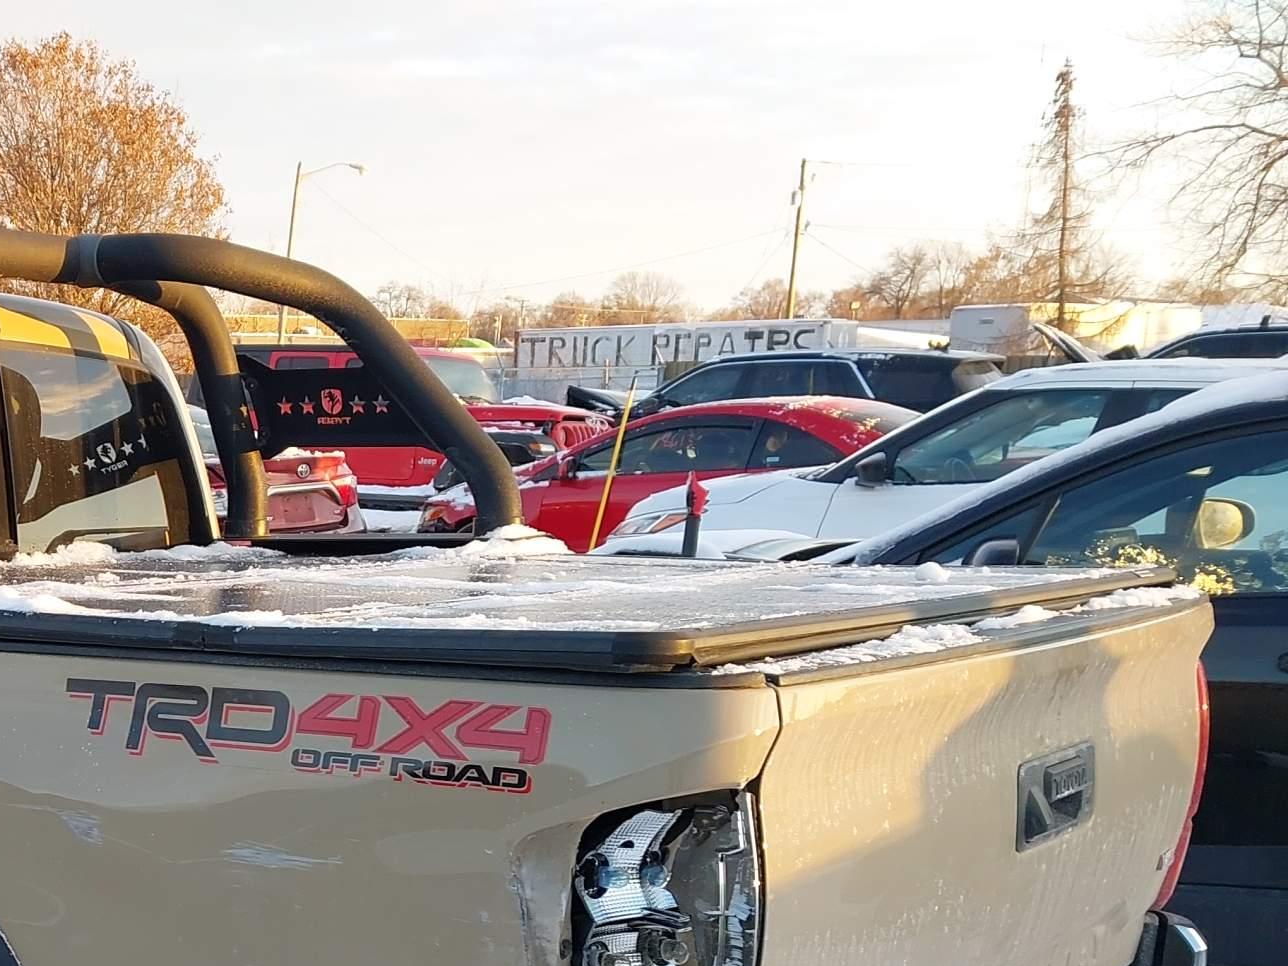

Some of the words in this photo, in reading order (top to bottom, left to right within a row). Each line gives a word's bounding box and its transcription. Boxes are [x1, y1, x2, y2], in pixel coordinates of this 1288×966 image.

[521, 335, 636, 368] TRUCK
[100, 459, 129, 474] TYGER
[417, 457, 437, 466] Jeep
[66, 678, 295, 764] TRD
[290, 747, 385, 777] OFF
[388, 757, 532, 794] ROAD
